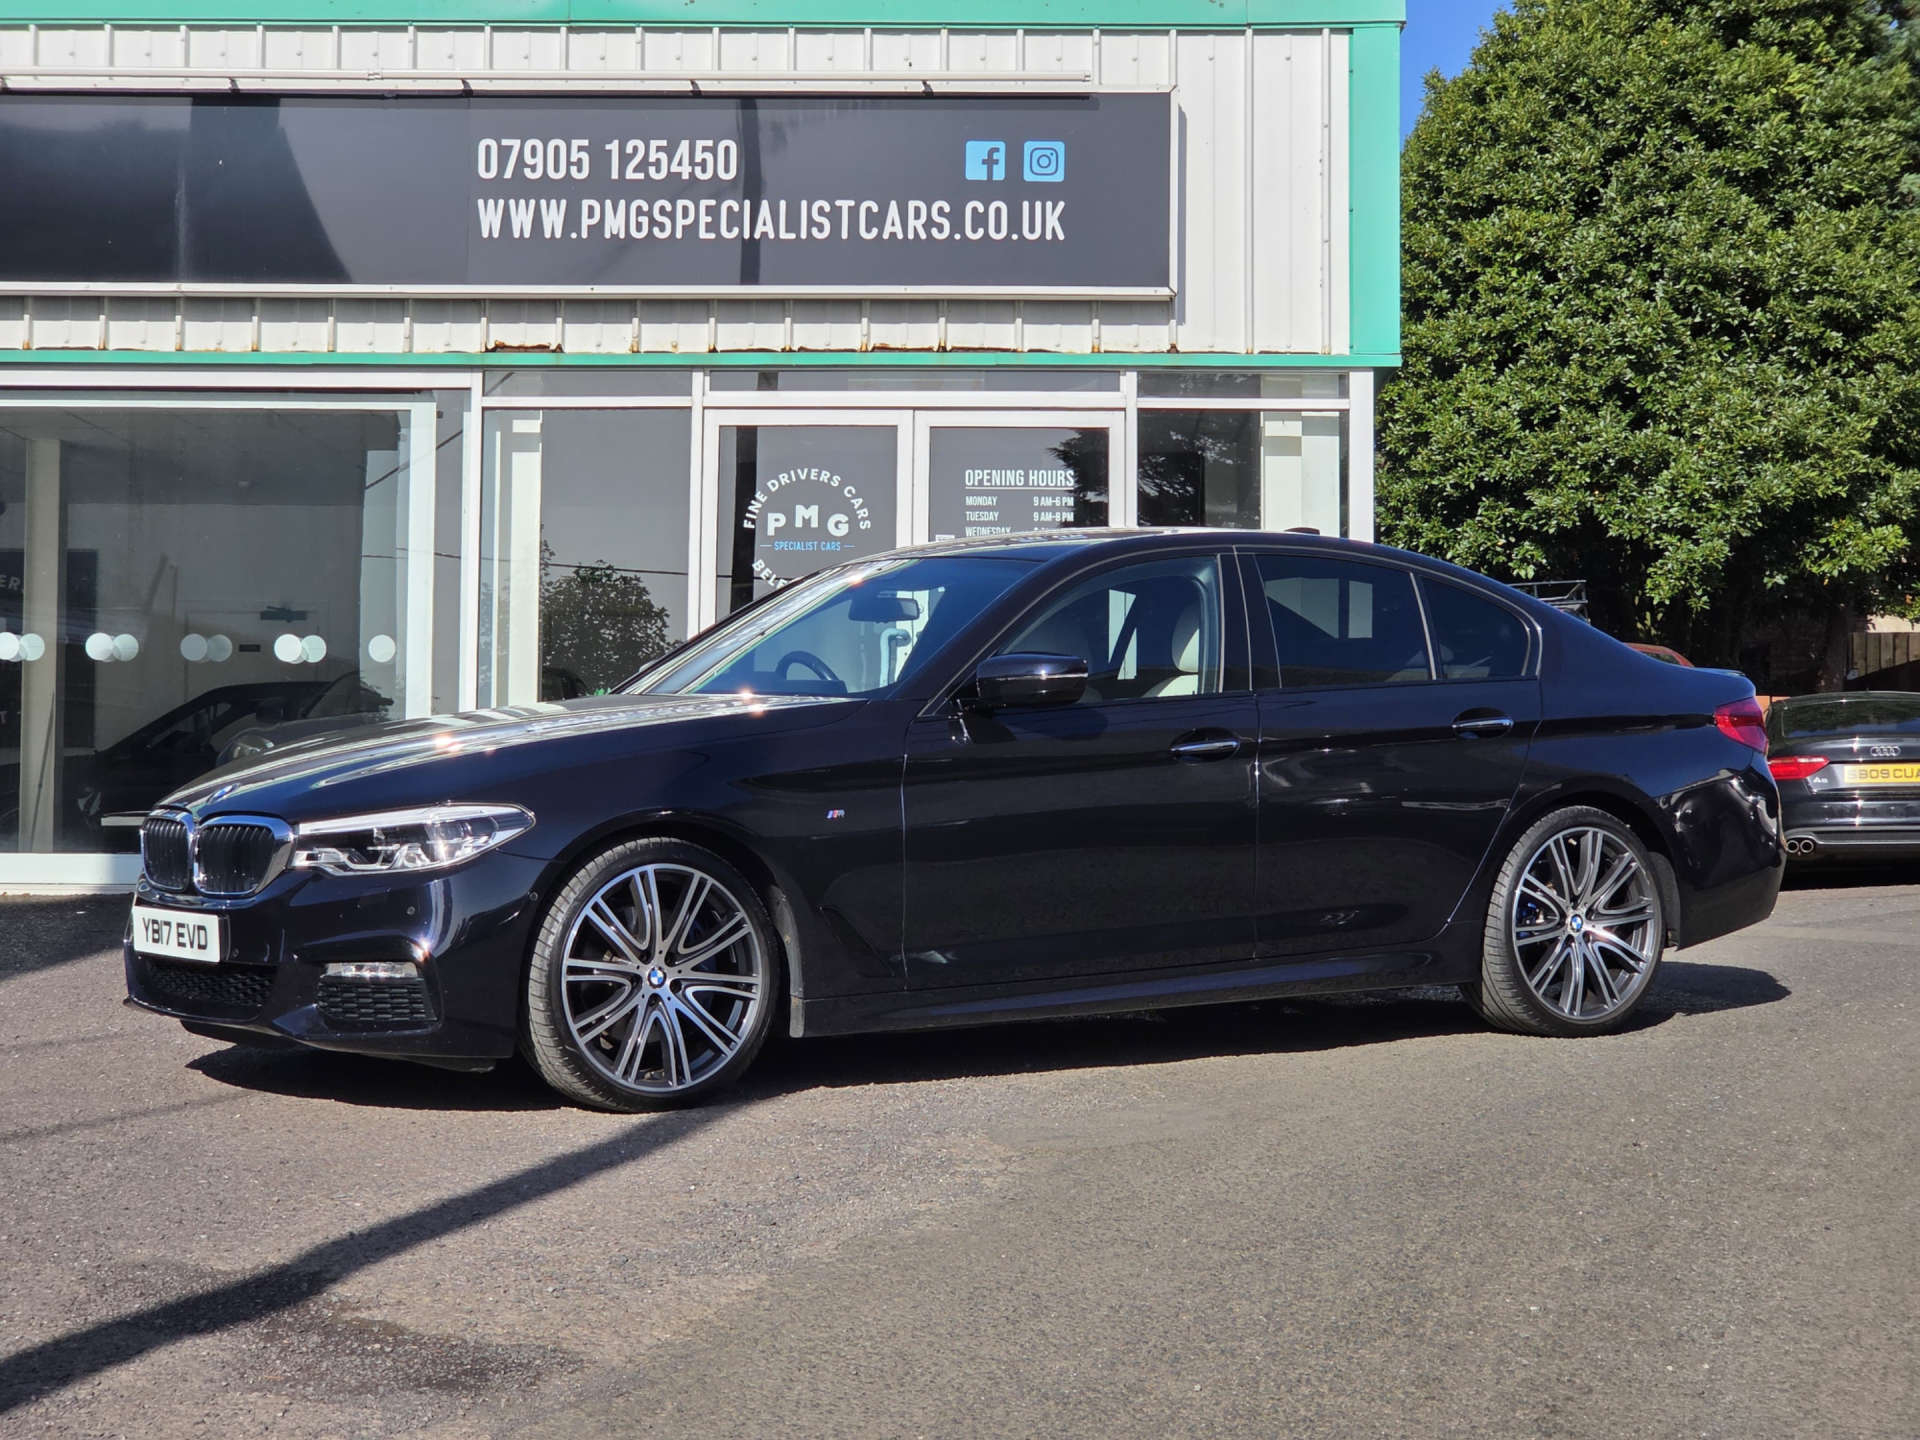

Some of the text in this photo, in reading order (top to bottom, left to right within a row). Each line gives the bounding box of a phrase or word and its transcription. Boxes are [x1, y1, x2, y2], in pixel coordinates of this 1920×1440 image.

[476, 138, 739, 181] 07905 125450
[477, 198, 1066, 240] WWW.PMGSPECIALISTCARS.CO.UK
[965, 469, 1075, 487] OPENING HOURS
[743, 467, 872, 531] FINE DRIVERS CARS
[965, 495, 998, 507] MONDAY
[1033, 496, 1039, 507] 9
[1062, 496, 1075, 507] PM
[766, 504, 849, 537] PMG
[965, 511, 1000, 522] TUESDAY
[1033, 511, 1039, 522] 9
[1062, 511, 1075, 522] PM
[774, 541, 841, 552] SPECIALIST CARS
[142, 917, 209, 951] YB17 EVD
